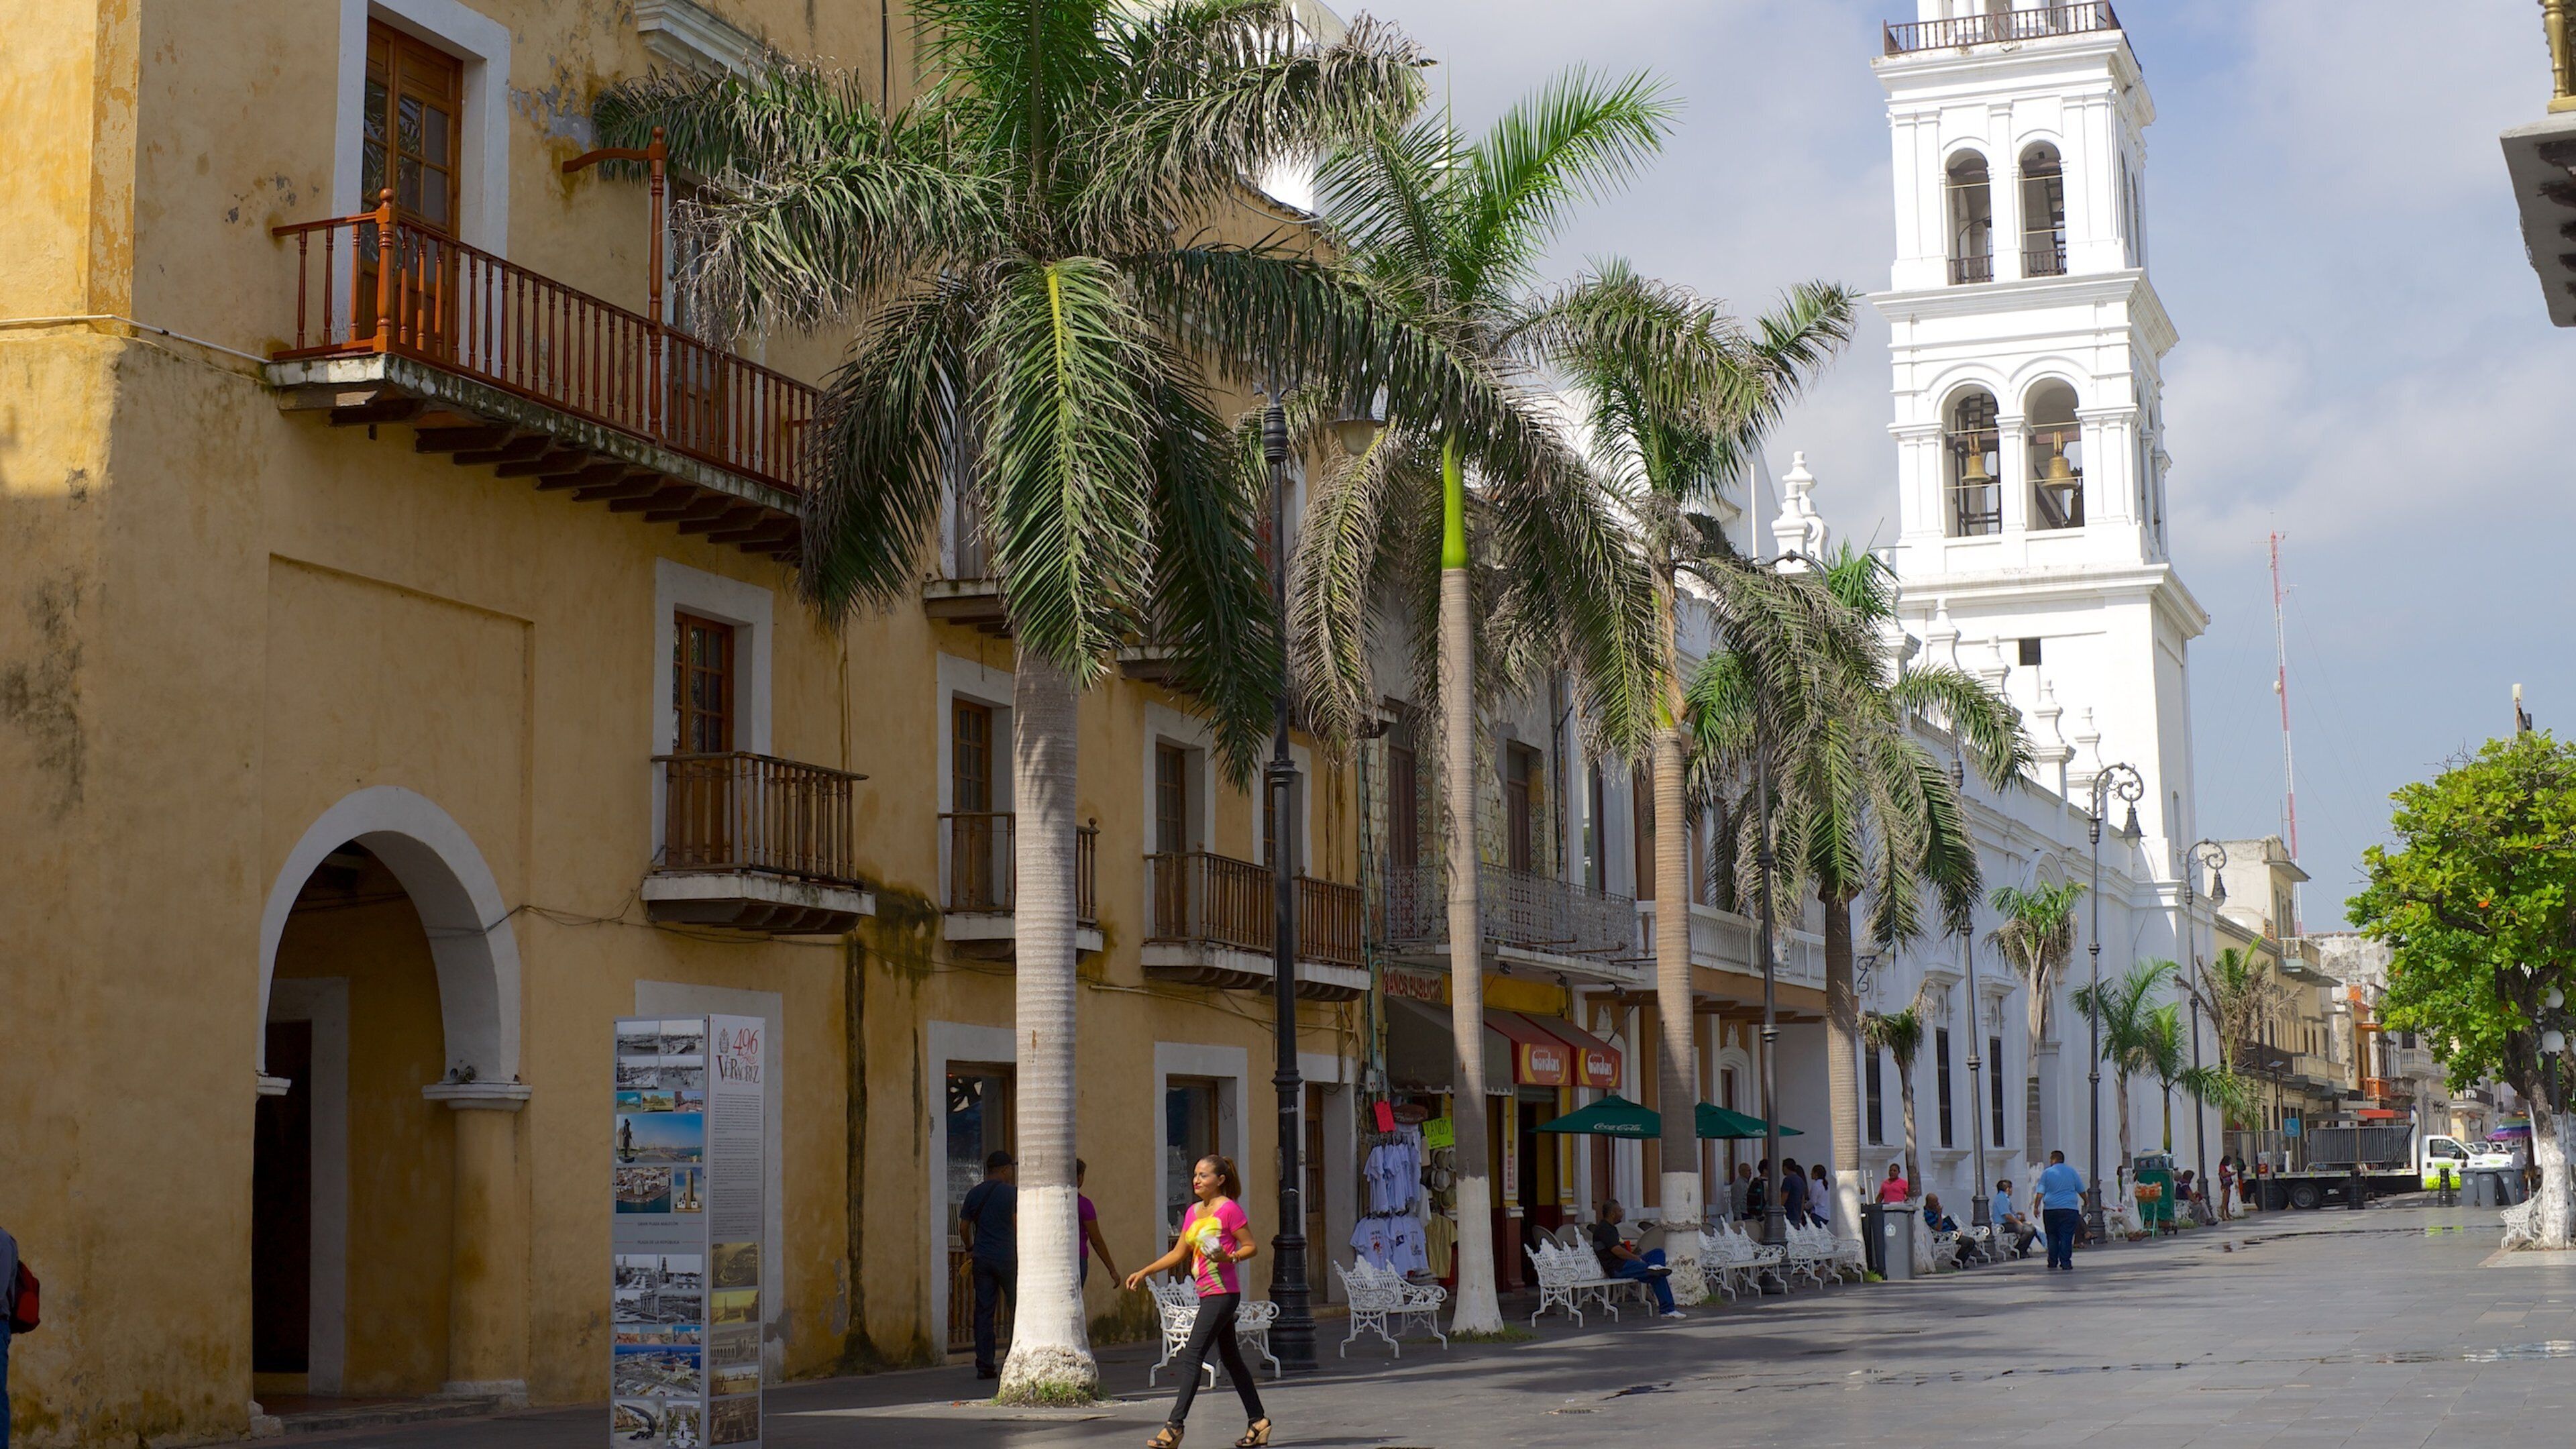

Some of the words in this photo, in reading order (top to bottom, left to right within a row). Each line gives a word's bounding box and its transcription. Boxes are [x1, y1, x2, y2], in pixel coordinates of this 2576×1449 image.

[733, 1028, 759, 1056] 496
[1532, 1051, 1560, 1072] Gordas
[1587, 1055, 1613, 1076] Gordas
[1594, 1122, 1642, 1132] Coca-Cola
